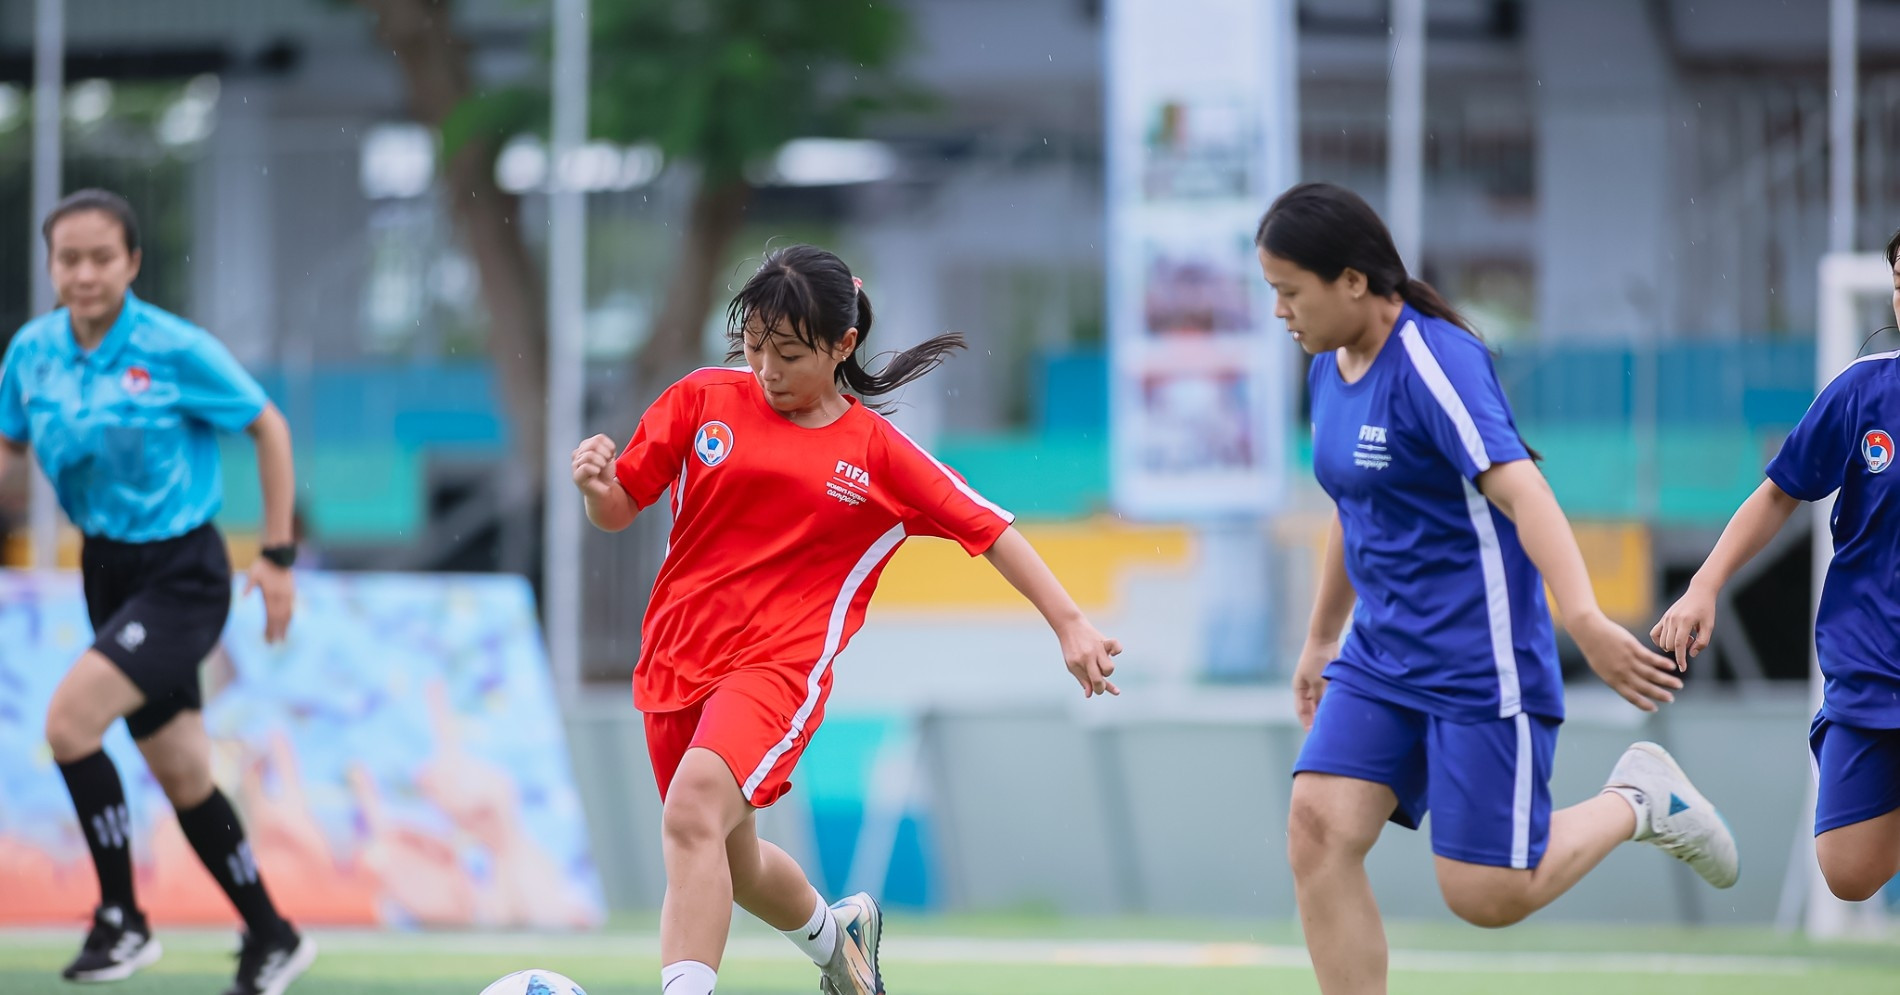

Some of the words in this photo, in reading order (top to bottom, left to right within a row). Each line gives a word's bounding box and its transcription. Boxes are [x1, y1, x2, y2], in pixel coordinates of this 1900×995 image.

[1359, 425, 1386, 443] FIFA
[835, 460, 870, 487] FIFA
[826, 489, 860, 506] campaign
